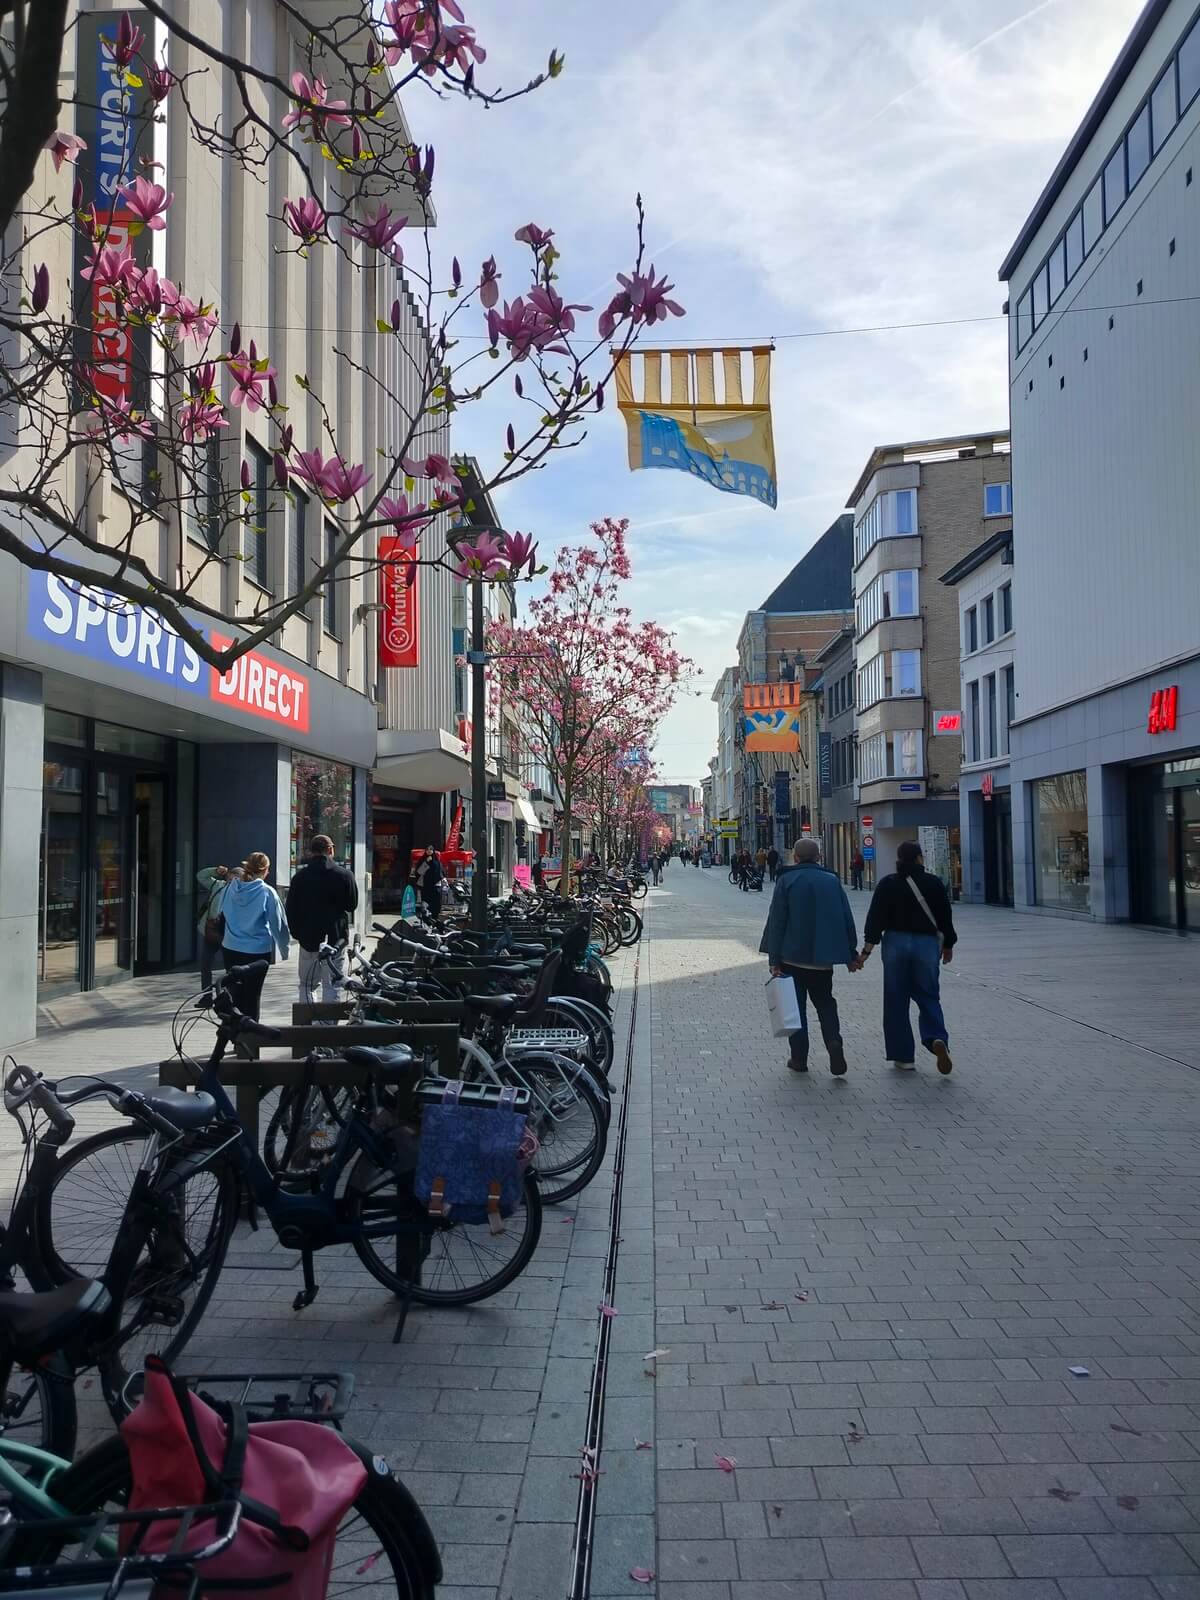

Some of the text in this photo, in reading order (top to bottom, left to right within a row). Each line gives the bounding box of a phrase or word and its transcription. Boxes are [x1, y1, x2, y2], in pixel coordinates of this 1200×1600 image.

[97, 224, 128, 382] DECT
[43, 572, 304, 721] SPORTS DIRECT
[391, 558, 406, 627] Kruidva
[1147, 686, 1177, 734] H&M
